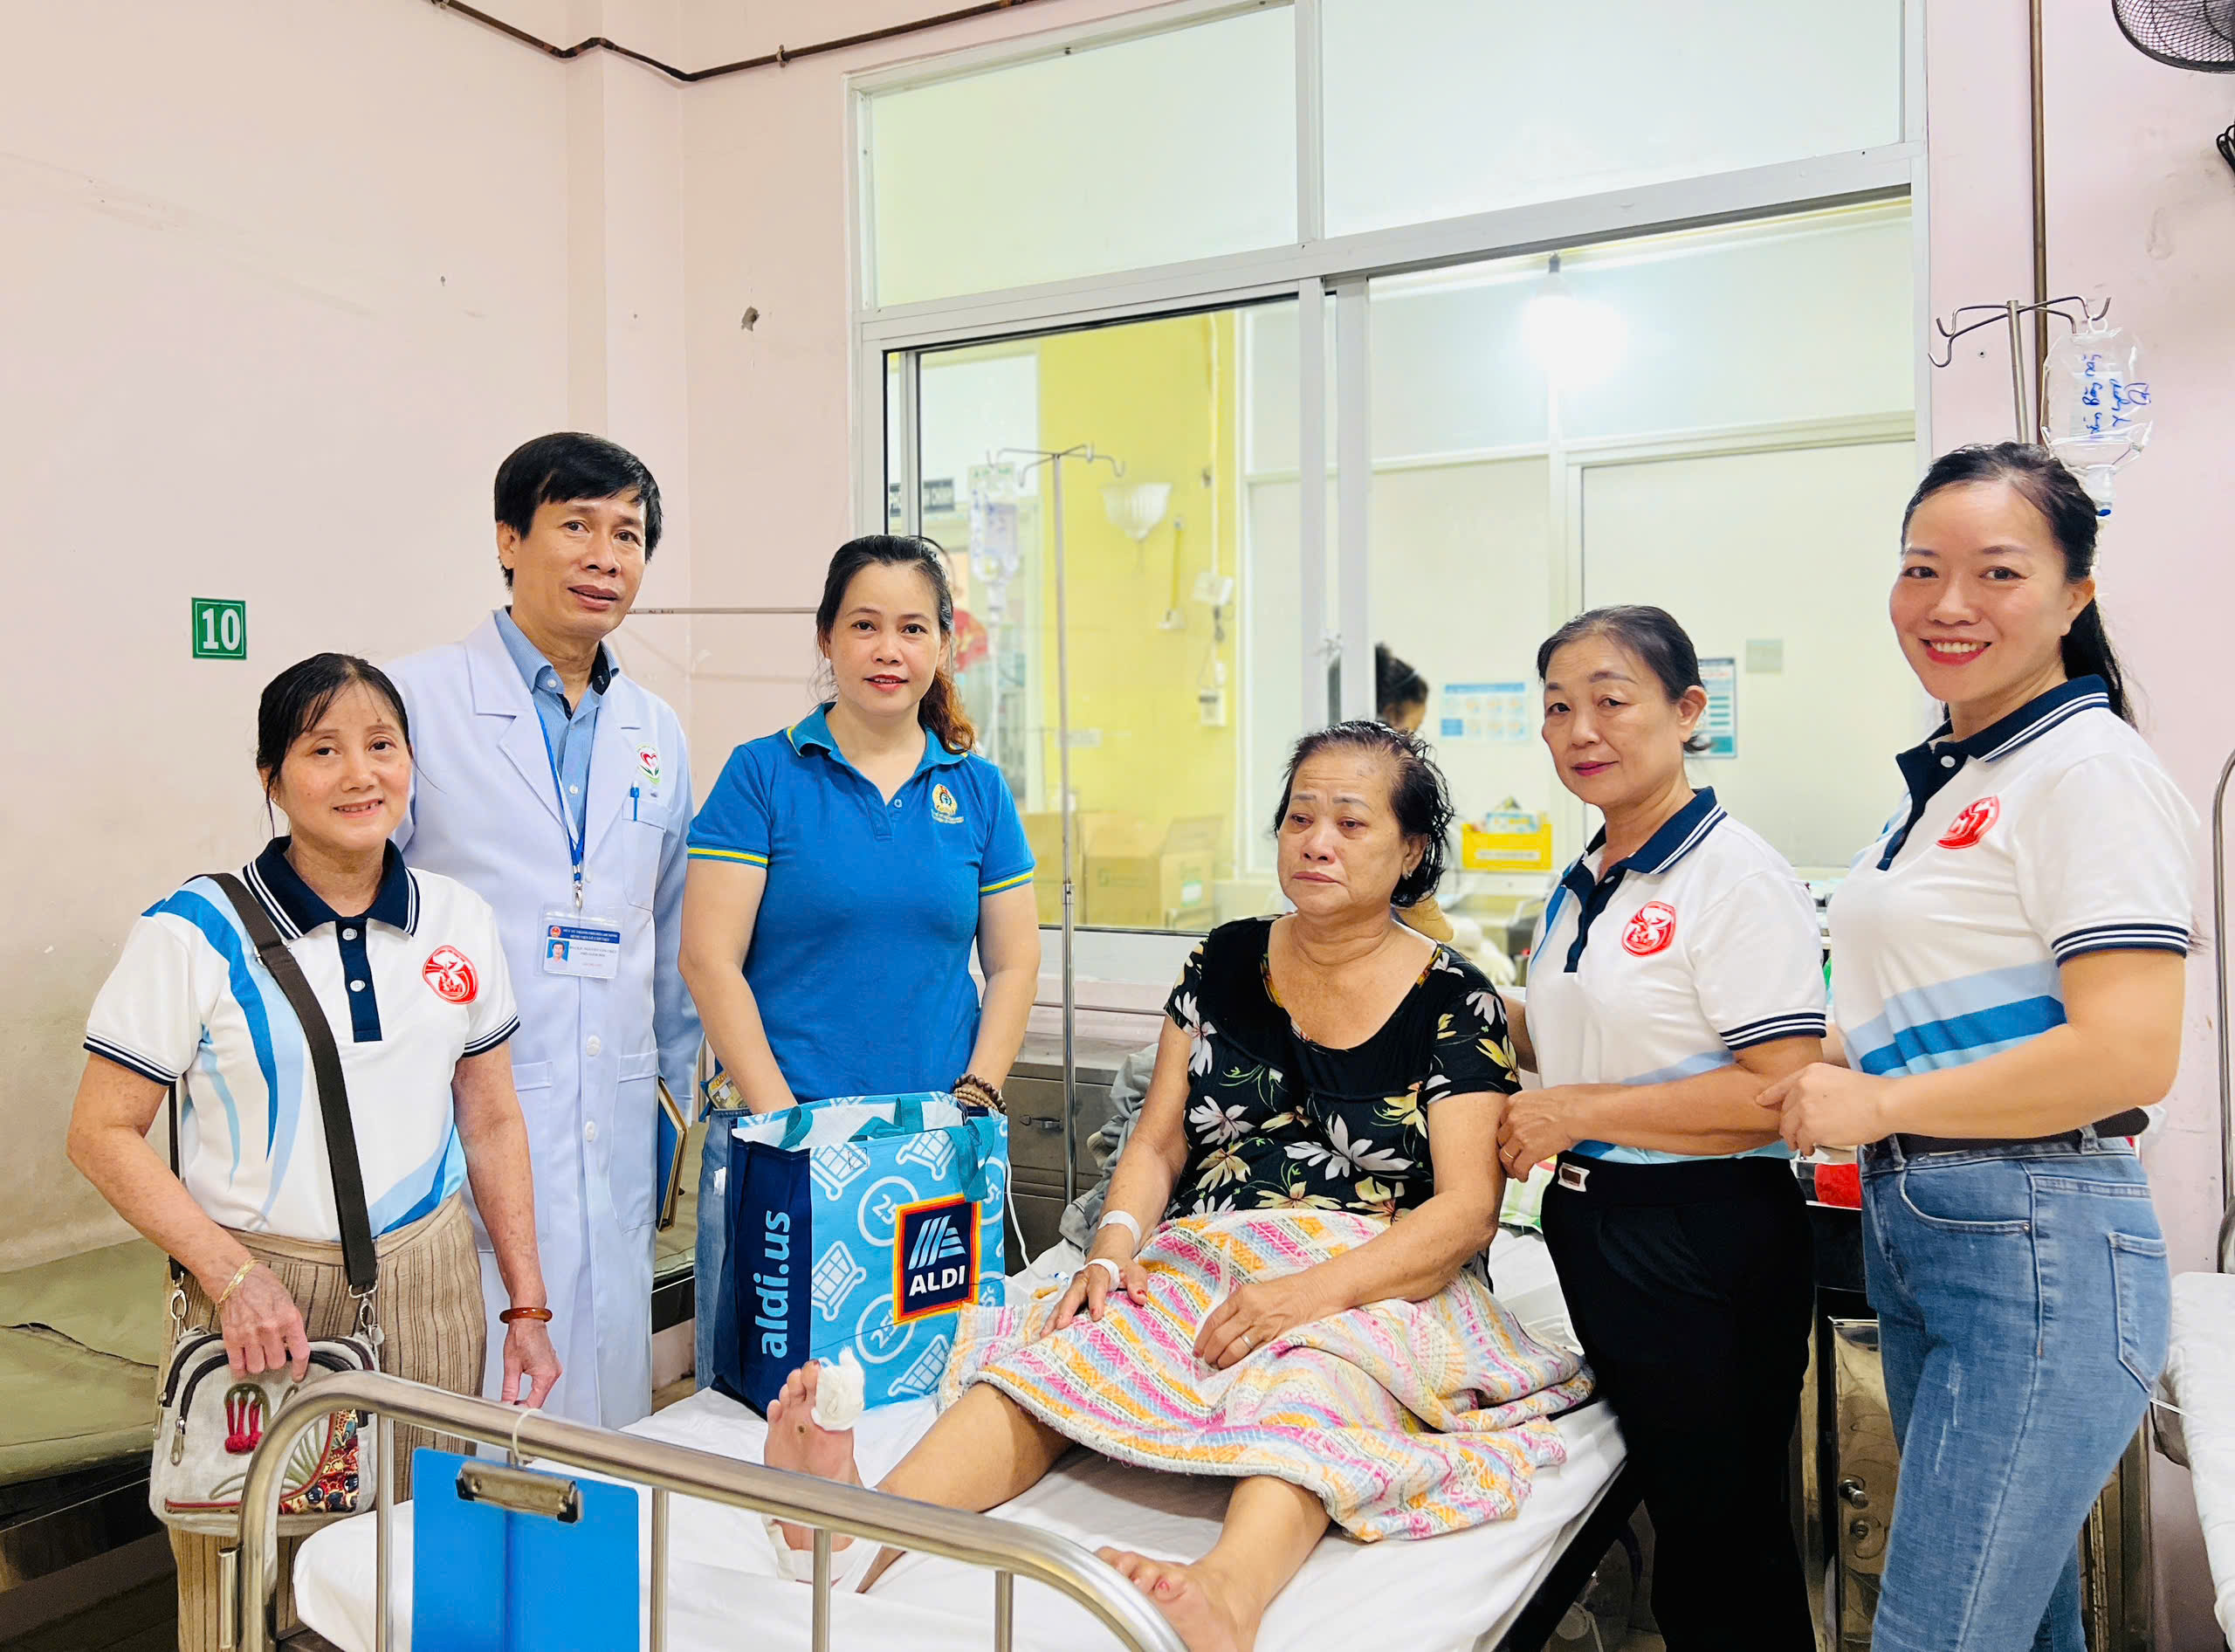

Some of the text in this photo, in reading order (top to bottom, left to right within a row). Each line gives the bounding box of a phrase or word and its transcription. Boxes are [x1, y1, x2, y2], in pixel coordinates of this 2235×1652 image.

[202, 608, 241, 651] 10
[753, 1209, 791, 1359] aldi.us
[908, 1264, 966, 1298] ALDI
